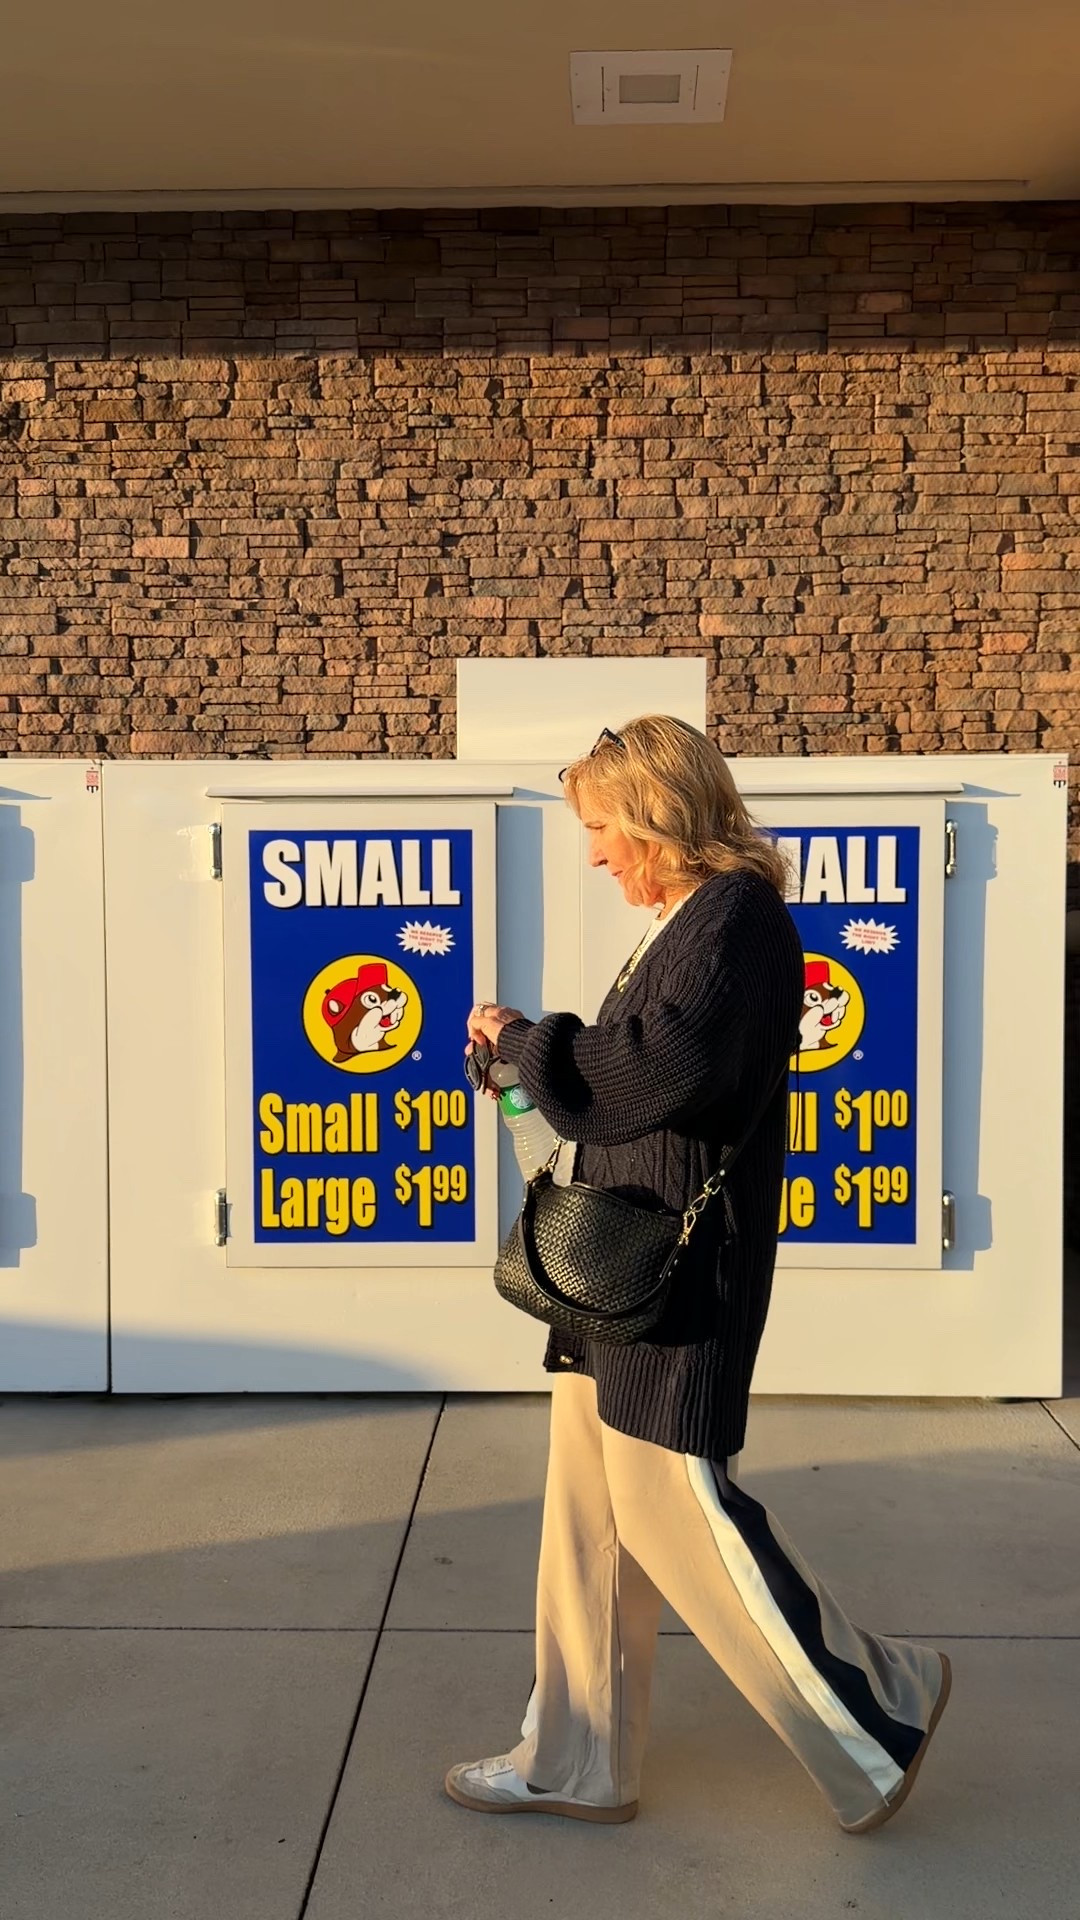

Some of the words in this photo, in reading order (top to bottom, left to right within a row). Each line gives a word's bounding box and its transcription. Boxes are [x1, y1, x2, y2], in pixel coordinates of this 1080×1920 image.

[263, 838, 461, 908] SMALL
[766, 834, 908, 904] ALL
[259, 1092, 379, 1154] Small
[260, 1168, 377, 1236] Large
